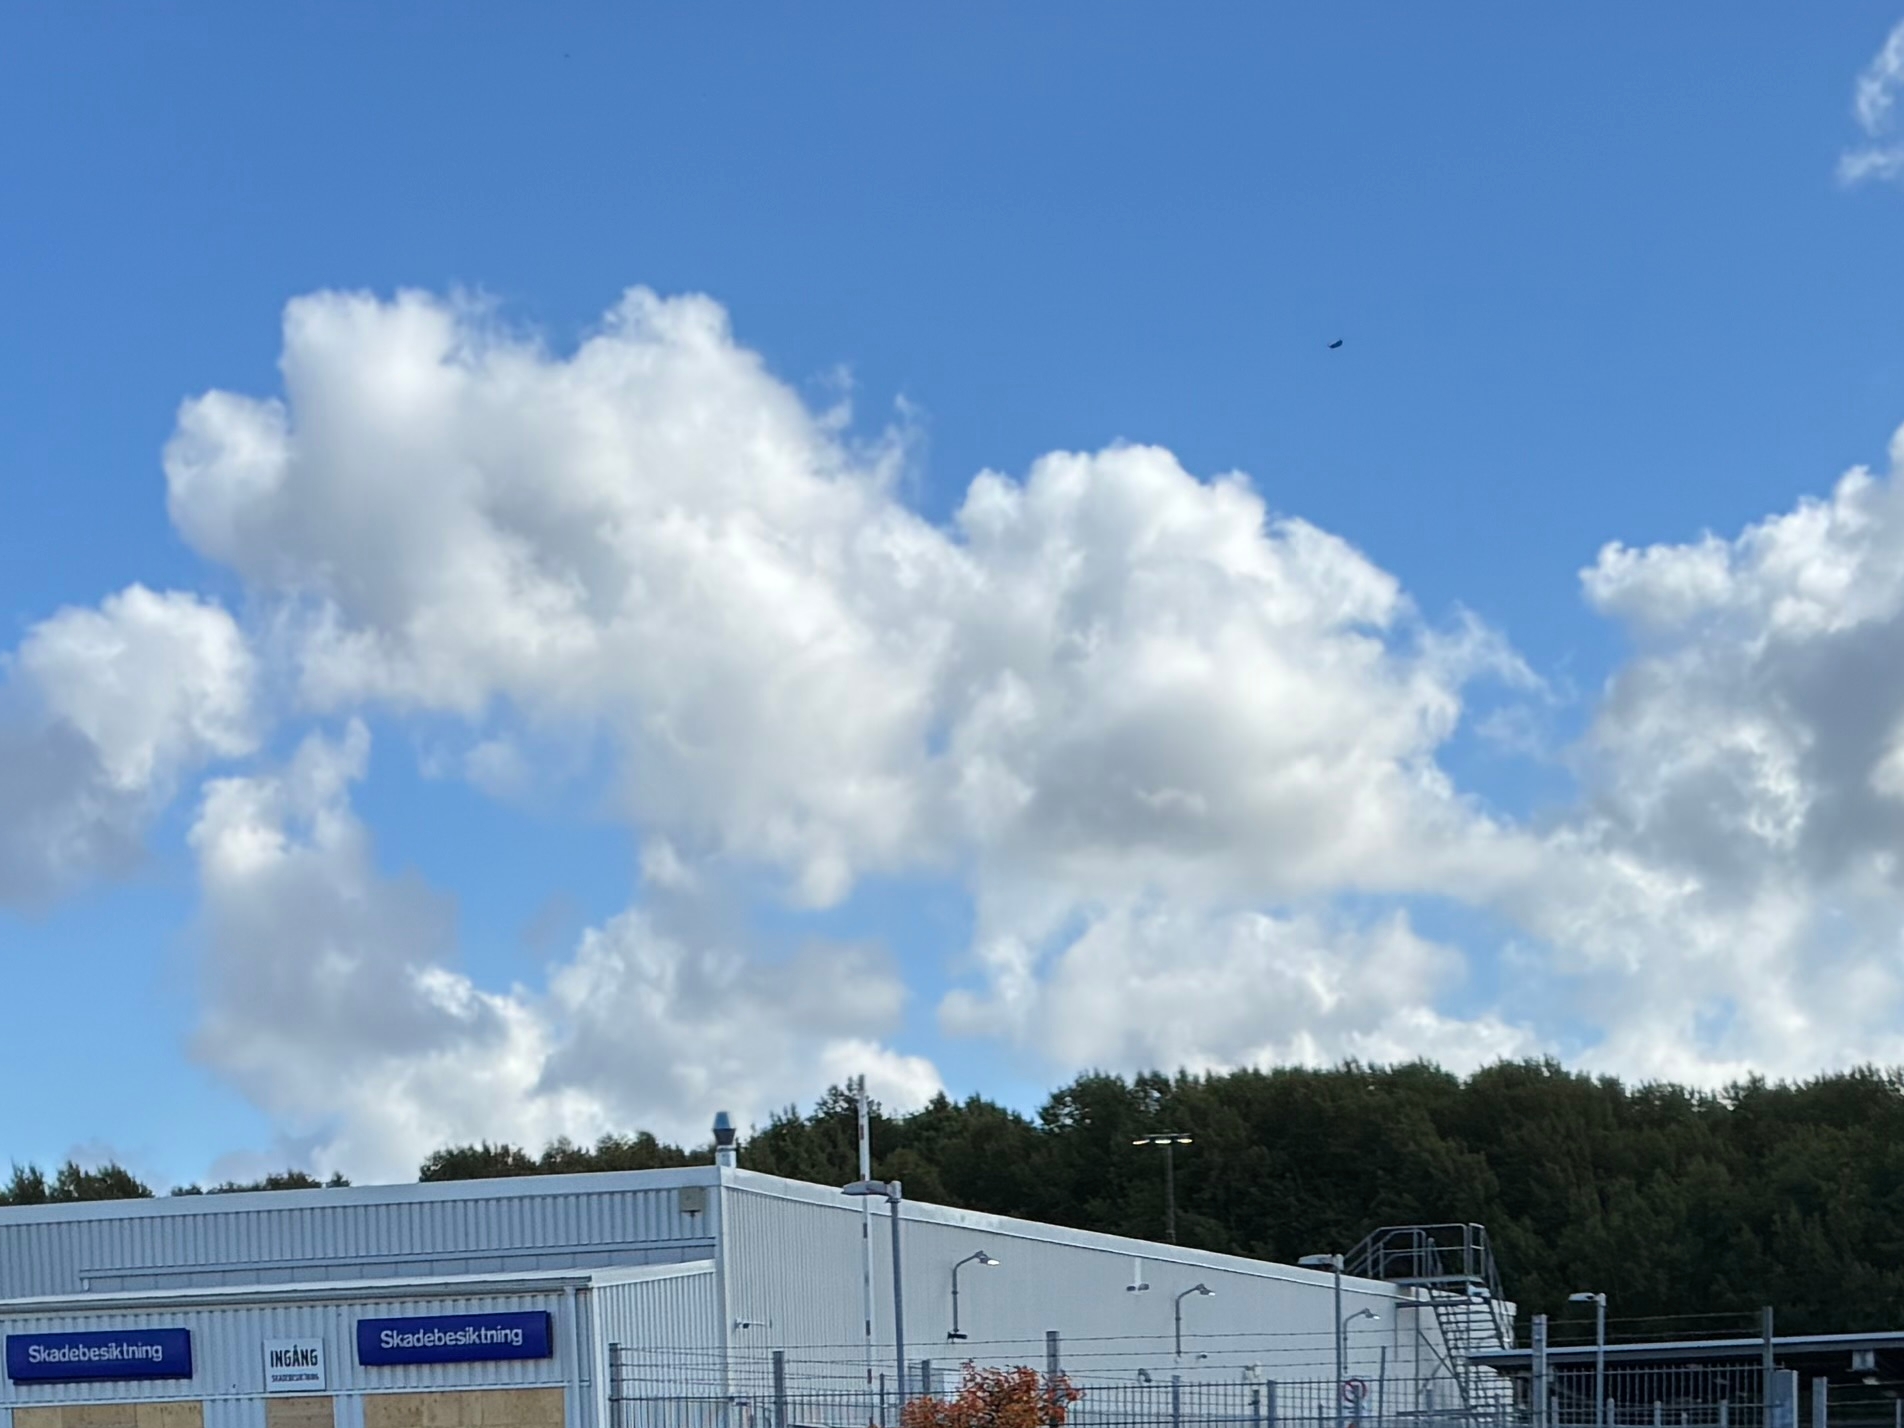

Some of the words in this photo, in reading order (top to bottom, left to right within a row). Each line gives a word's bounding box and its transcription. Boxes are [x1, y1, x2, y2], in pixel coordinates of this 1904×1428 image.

[380, 1326, 523, 1348] Skadebesiktning
[28, 1342, 163, 1363] Skadebesiktning
[270, 1344, 318, 1368] INGÅNG
